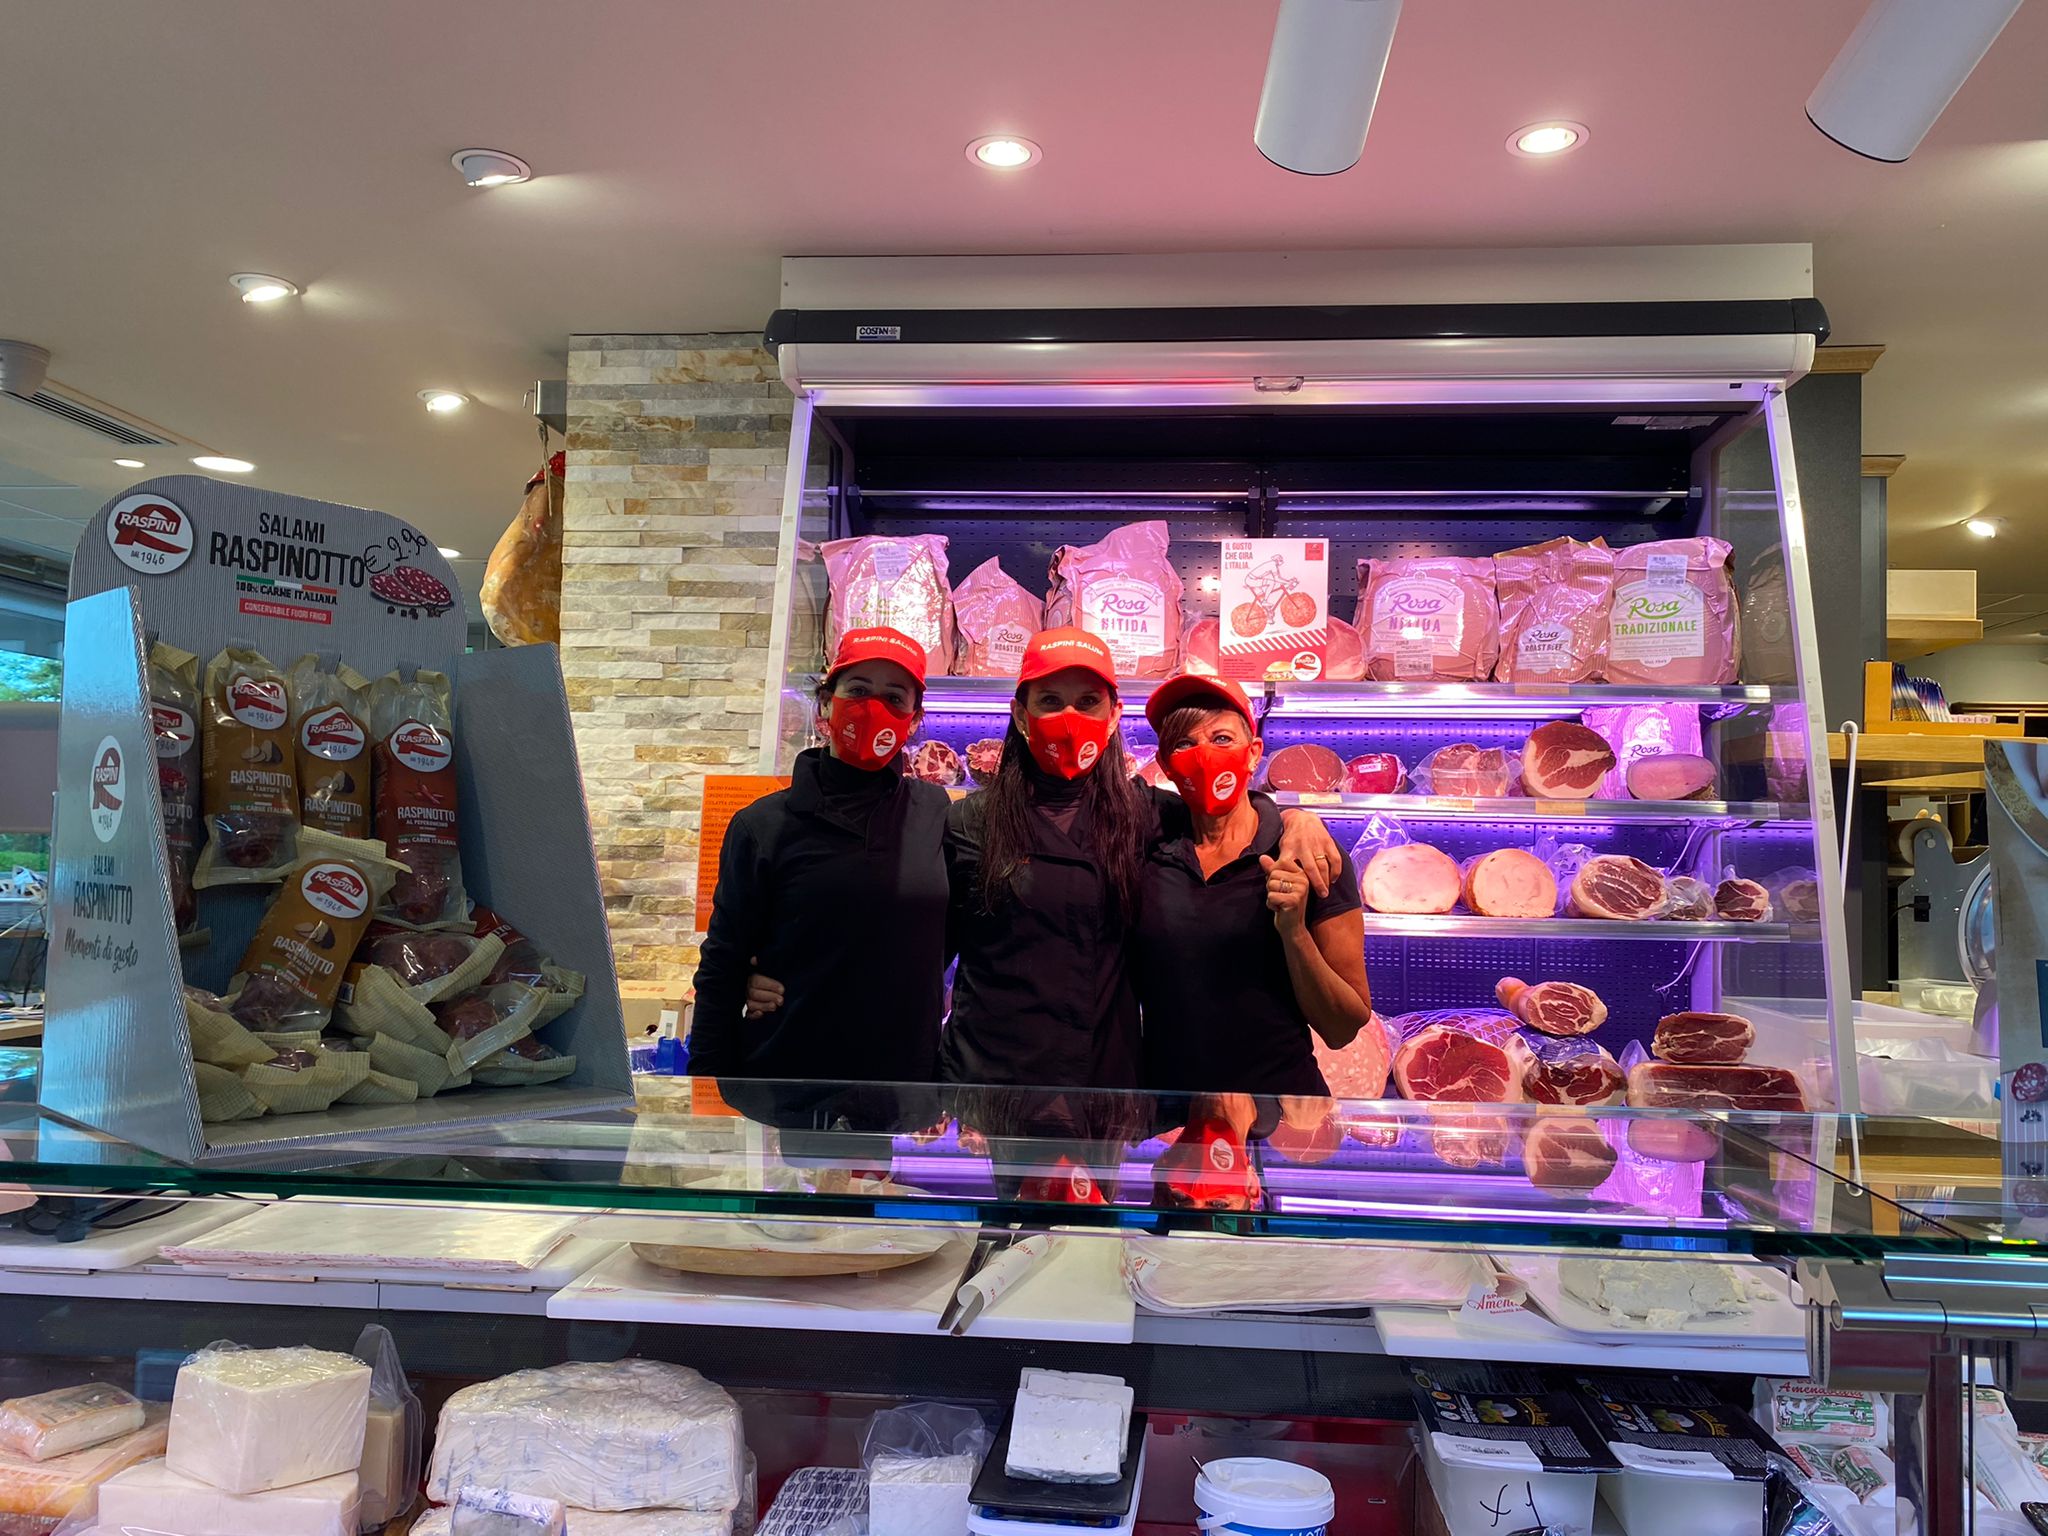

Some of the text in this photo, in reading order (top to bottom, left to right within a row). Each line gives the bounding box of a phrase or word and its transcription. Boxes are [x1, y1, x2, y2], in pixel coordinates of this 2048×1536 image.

[119, 513, 177, 533] RASPINI
[259, 512, 325, 544] SALAMI
[1225, 542, 1252, 551] IL GUSTO
[141, 552, 165, 566] 1946
[209, 531, 364, 588] RASPINOTTO
[1225, 552, 1253, 560] CHE GIRA
[236, 581, 338, 605] 100% CARNE ITALIANA
[244, 601, 327, 622] CONSERVABILE FUORI FRIGO
[1100, 593, 1150, 616] Rosa
[1389, 592, 1446, 616] Rosa
[1627, 596, 1684, 620] Rosa
[1101, 618, 1148, 633] NITIDA
[1614, 620, 1697, 636] TRADIZIONALE
[853, 635, 888, 645] RASPINI
[998, 629, 1024, 643] Rosa
[1529, 629, 1561, 642] Rosa
[994, 643, 1013, 652] ROAST
[1040, 640, 1104, 657] RASPINI SALUMI
[1525, 644, 1546, 652] ROAST
[255, 711, 274, 723] 1946
[311, 722, 352, 733] RASPINI
[399, 734, 440, 745] RASPINI
[1631, 744, 1663, 757] Rosa
[417, 756, 435, 766] 1946
[94, 766, 119, 782] RASPINI
[231, 770, 292, 787] RASPINOTTO
[305, 798, 362, 817] RASPINOTTO
[397, 806, 455, 822] RASPINOTTO
[93, 855, 115, 876] SALAMI
[315, 872, 360, 896] RASPINI
[73, 881, 133, 926] RASPINOTTO
[323, 899, 342, 912] 1946
[65, 927, 139, 973] Momenti di gusto
[273, 935, 334, 975] RASPINOTTO
